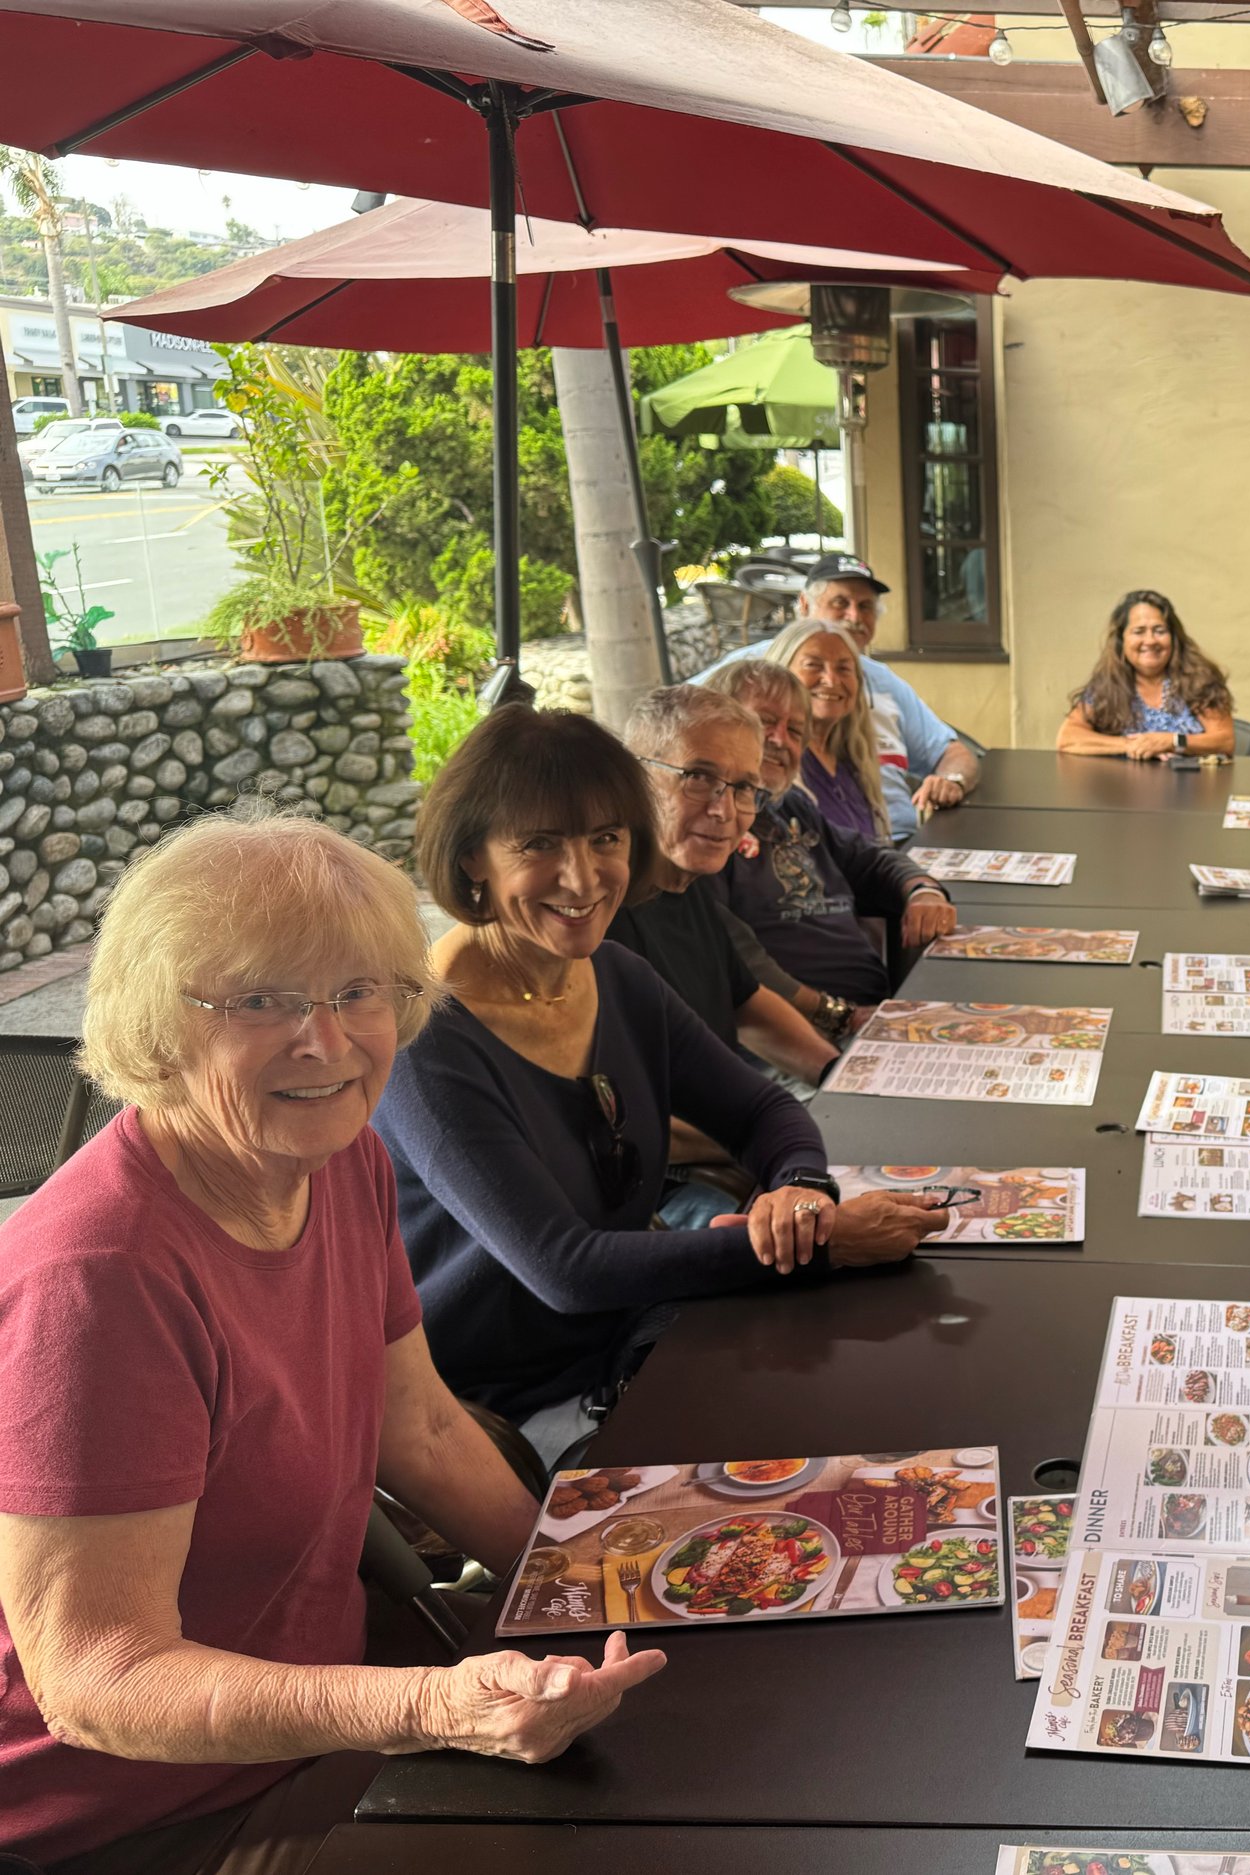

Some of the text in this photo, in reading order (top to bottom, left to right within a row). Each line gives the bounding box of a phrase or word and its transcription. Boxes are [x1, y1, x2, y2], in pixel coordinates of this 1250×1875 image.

[1116, 1314, 1138, 1367] BREAKFAST
[840, 1494, 877, 1550] Our Tables
[883, 1495, 898, 1544] AROUND
[898, 1497, 914, 1541] GATHER
[1083, 1489, 1108, 1542] DINNER
[1113, 1569, 1126, 1601] TO SHARE
[1048, 1573, 1097, 1698] Seasonal BREAKFAST
[1089, 1674, 1105, 1708] BAKERY
